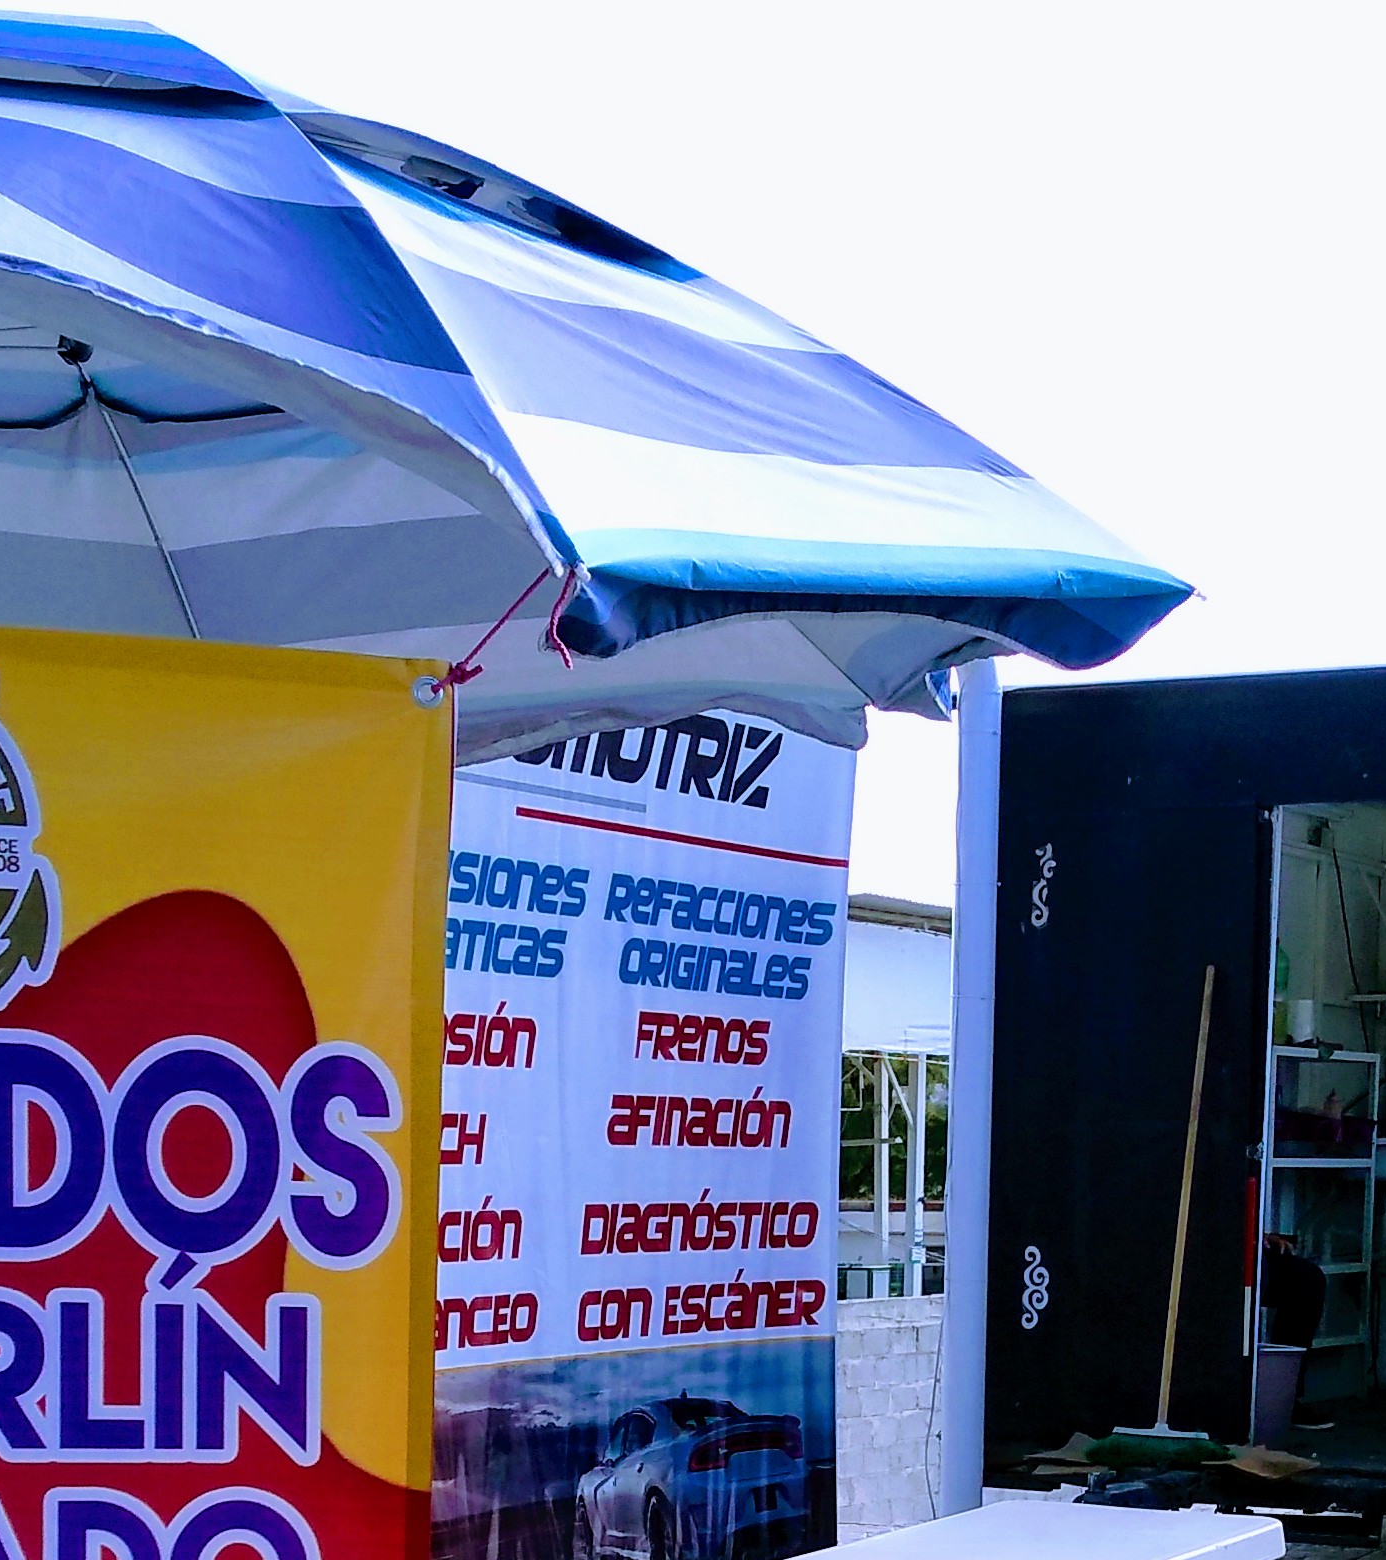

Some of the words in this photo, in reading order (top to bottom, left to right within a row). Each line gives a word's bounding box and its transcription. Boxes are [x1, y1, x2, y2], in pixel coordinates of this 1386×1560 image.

[513, 713, 783, 809] OTRIZ
[448, 850, 590, 917] SIONES
[443, 1001, 536, 1068] SIÓN
